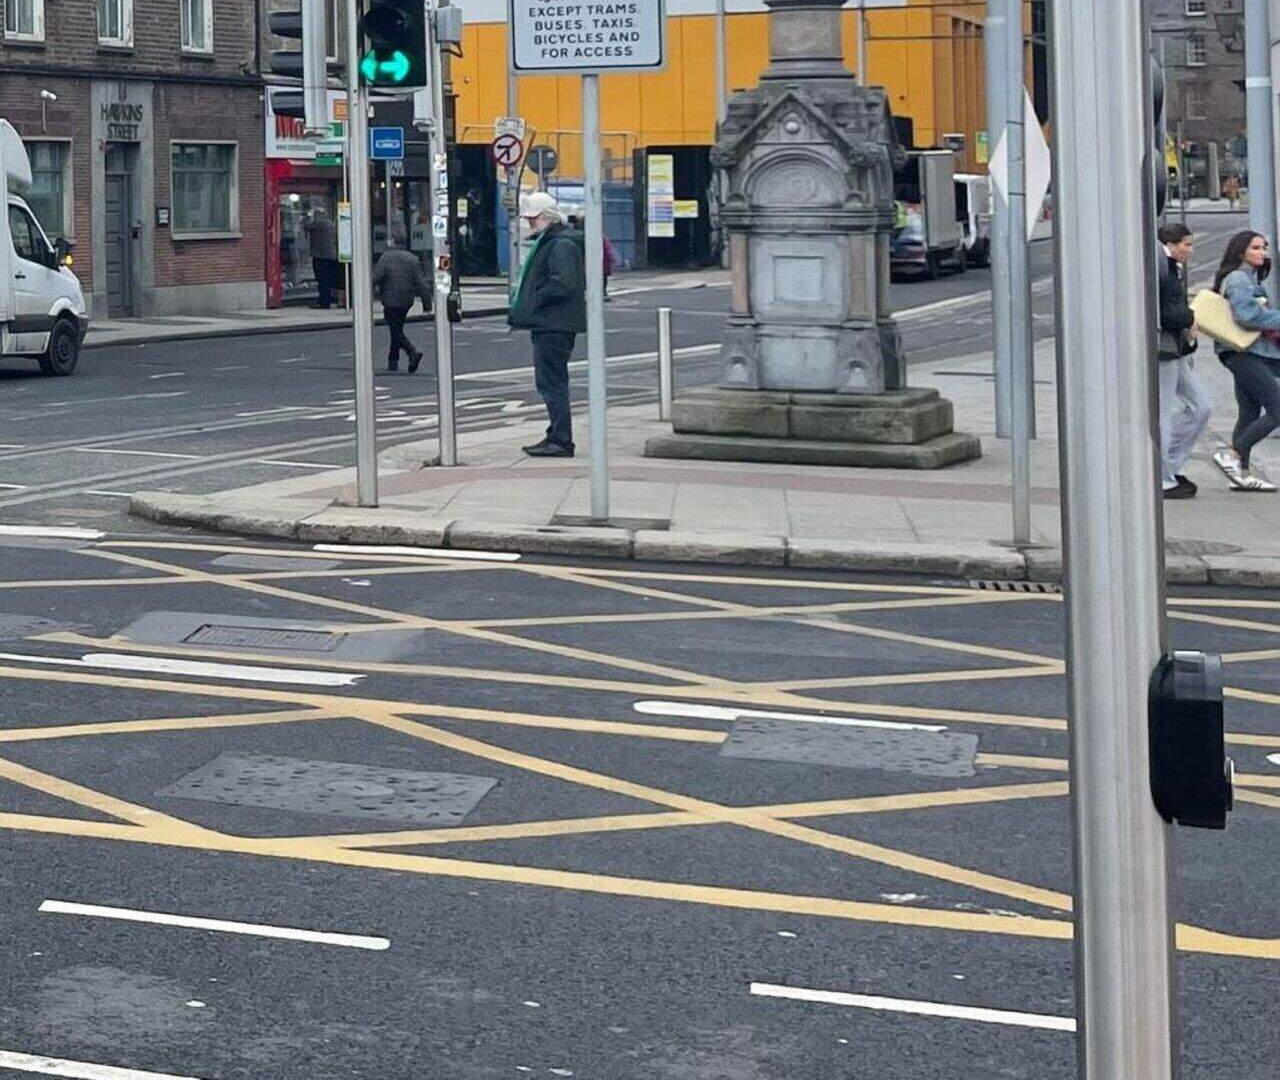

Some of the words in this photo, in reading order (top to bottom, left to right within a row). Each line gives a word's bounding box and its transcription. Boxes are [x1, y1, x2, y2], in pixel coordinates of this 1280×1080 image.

[528, 6, 582, 17] EXCEPT
[534, 33, 604, 45] BICYCLES
[609, 32, 640, 42] AND
[541, 48, 568, 58] FOR
[574, 46, 633, 57] ACCESS
[100, 103, 143, 121] HAWKINS
[107, 124, 138, 140] STREET
